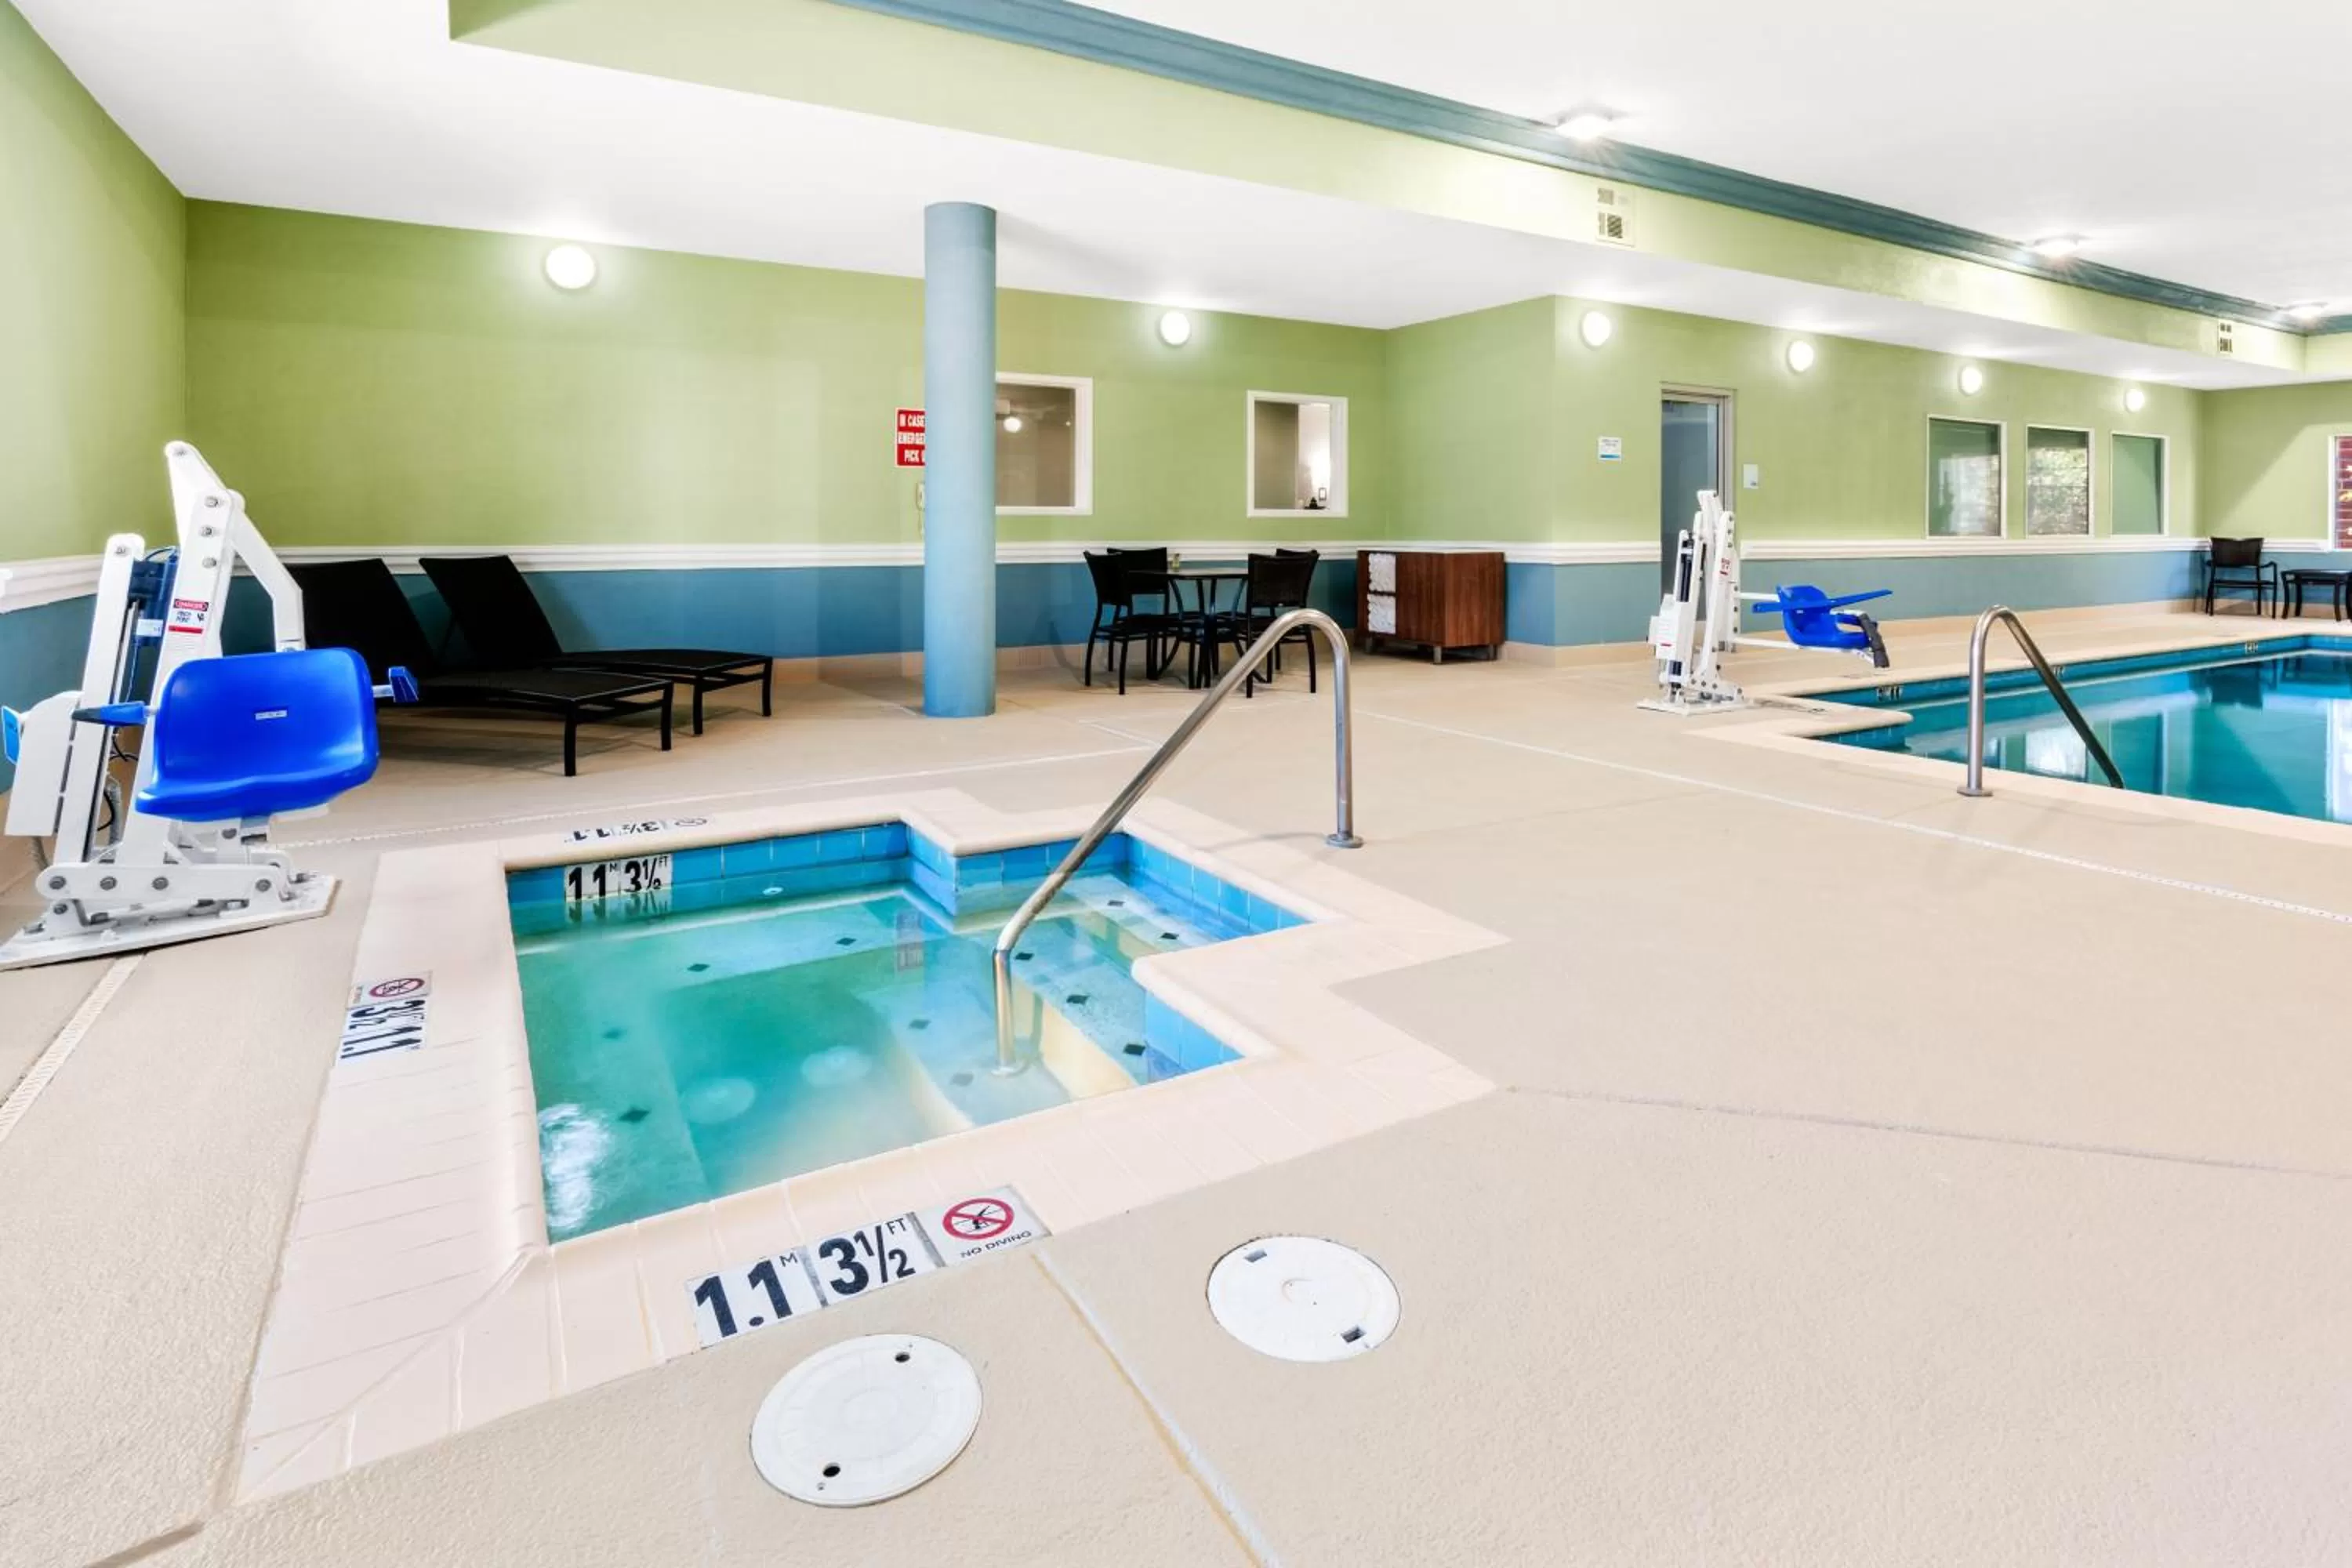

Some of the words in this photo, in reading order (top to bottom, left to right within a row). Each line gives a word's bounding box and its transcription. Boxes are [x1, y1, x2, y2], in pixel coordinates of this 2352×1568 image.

[907, 413, 925, 427] CASE
[904, 449, 920, 463] PICK
[960, 1247, 982, 1258] NO
[985, 1230, 1032, 1250] DIVING
[695, 1259, 792, 1338] 1.1
[780, 1254, 798, 1266] M
[887, 1217, 907, 1235] FT
